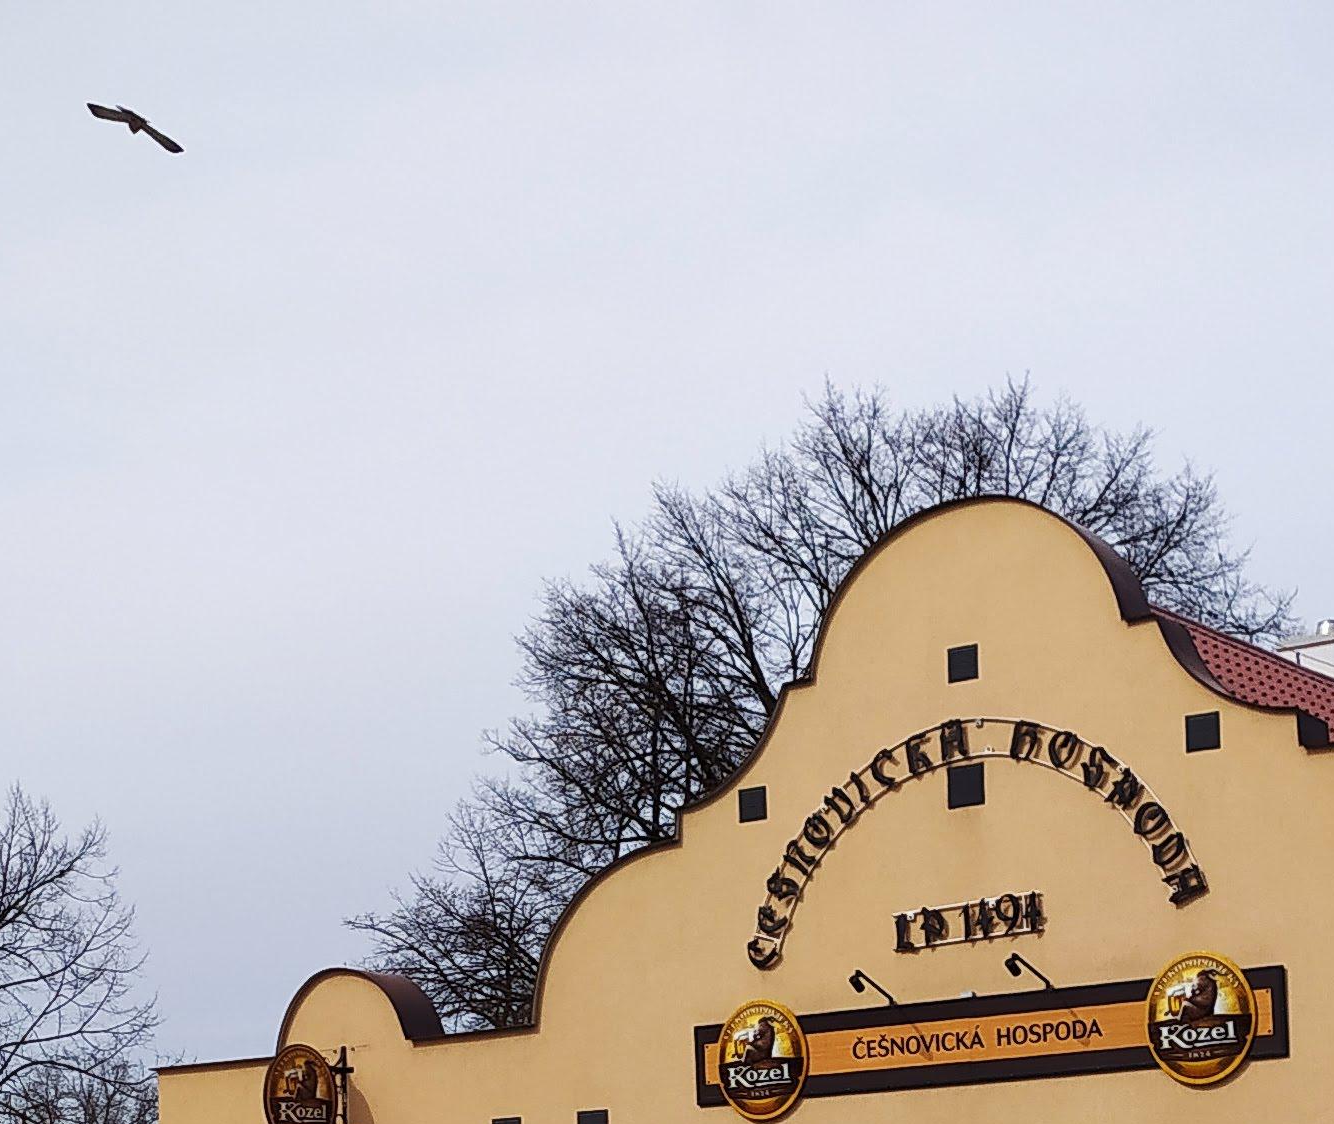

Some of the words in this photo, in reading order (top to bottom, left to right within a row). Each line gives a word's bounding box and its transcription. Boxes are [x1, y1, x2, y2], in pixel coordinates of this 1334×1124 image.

[852, 1025, 985, 1060] ČEŠNOVICKÁ
[996, 1018, 1103, 1047] HOSPODA
[1159, 1020, 1237, 1050] Kozel
[727, 1063, 791, 1089] Kozel
[278, 1101, 327, 1123] Kozel
